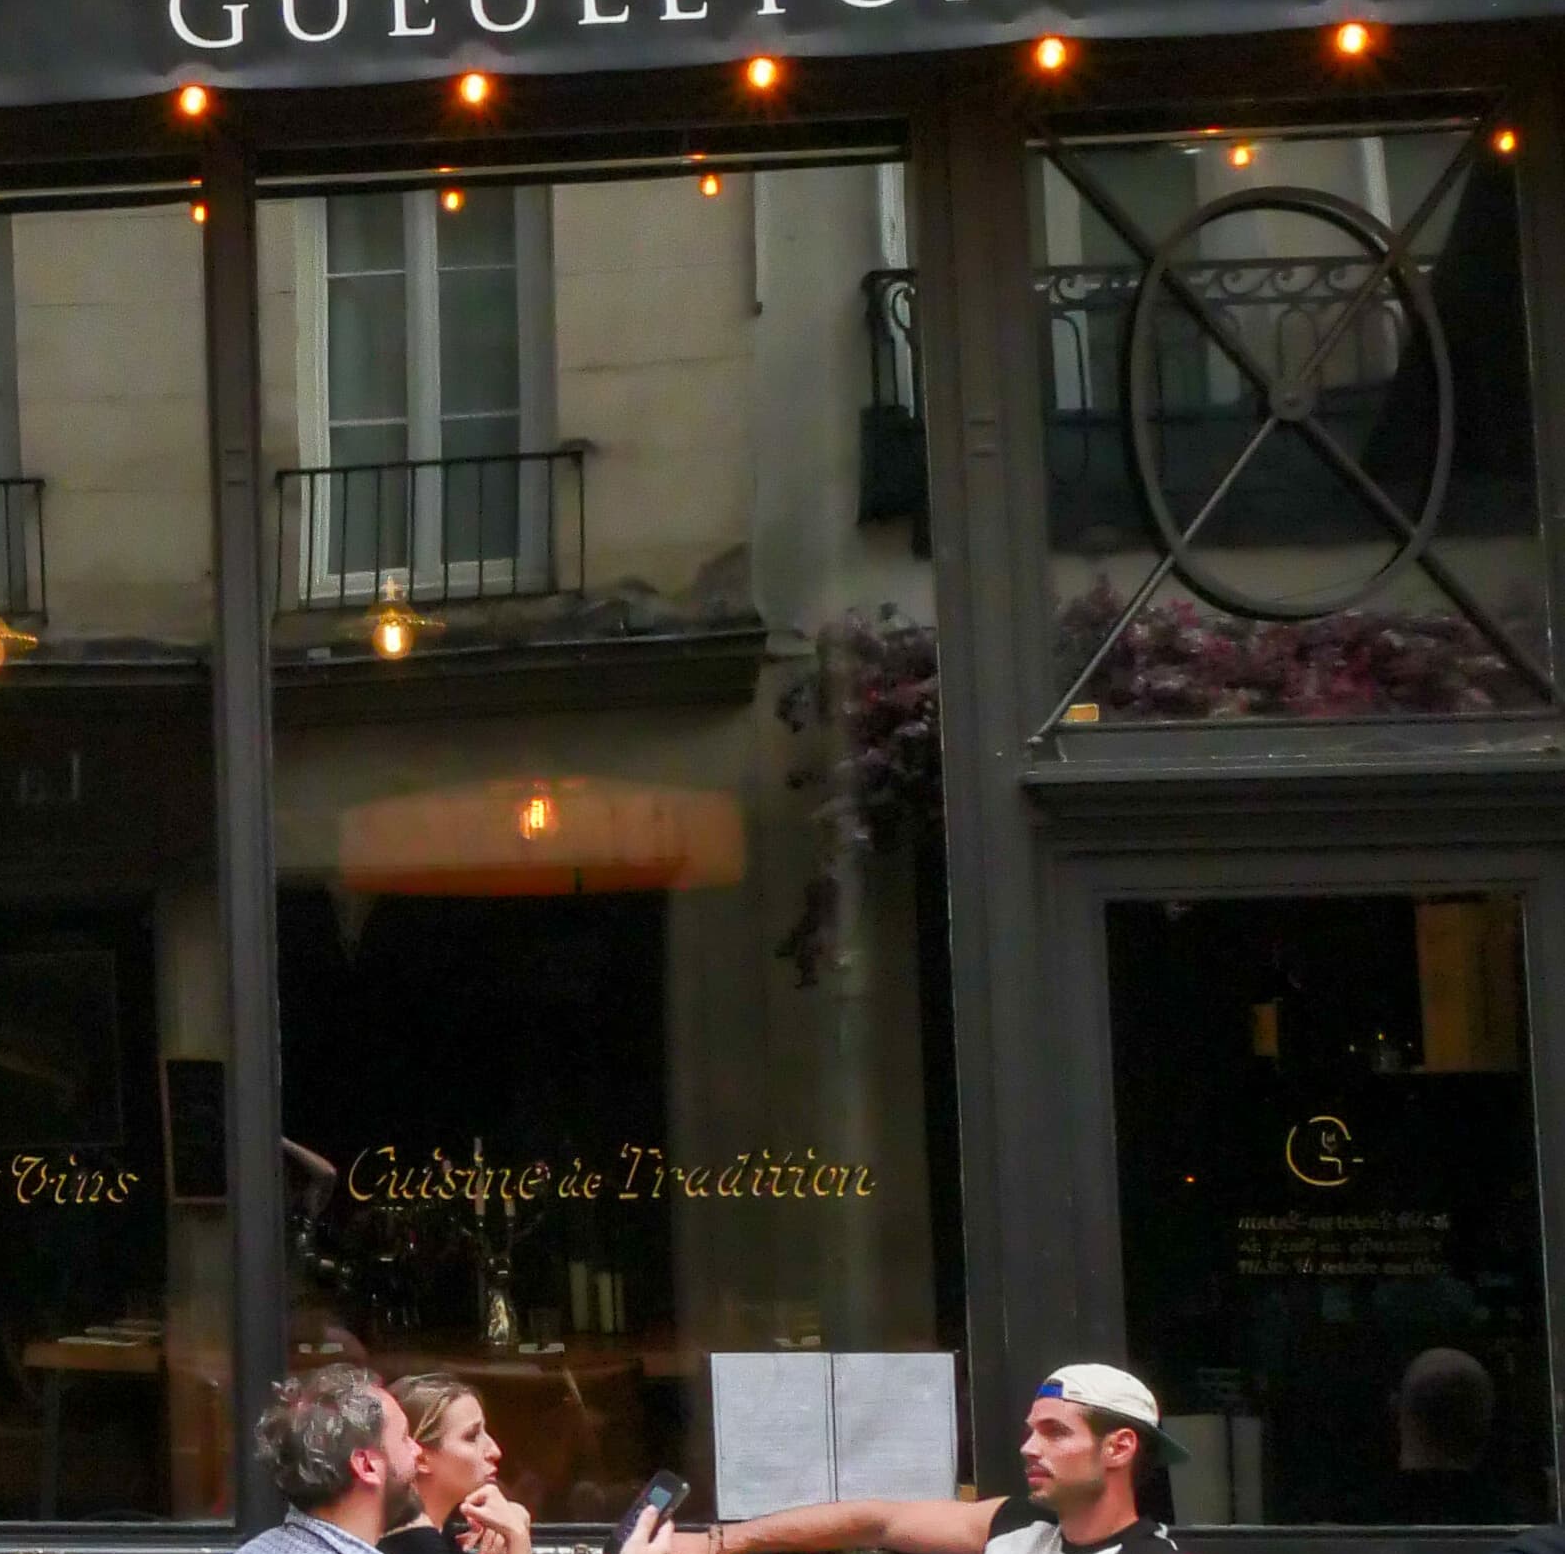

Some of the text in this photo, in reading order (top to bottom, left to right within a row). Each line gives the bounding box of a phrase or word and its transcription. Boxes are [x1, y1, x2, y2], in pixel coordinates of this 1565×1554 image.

[11, 1151, 141, 1206] Vins
[346, 1143, 877, 1202] Cuisine de Tradition
